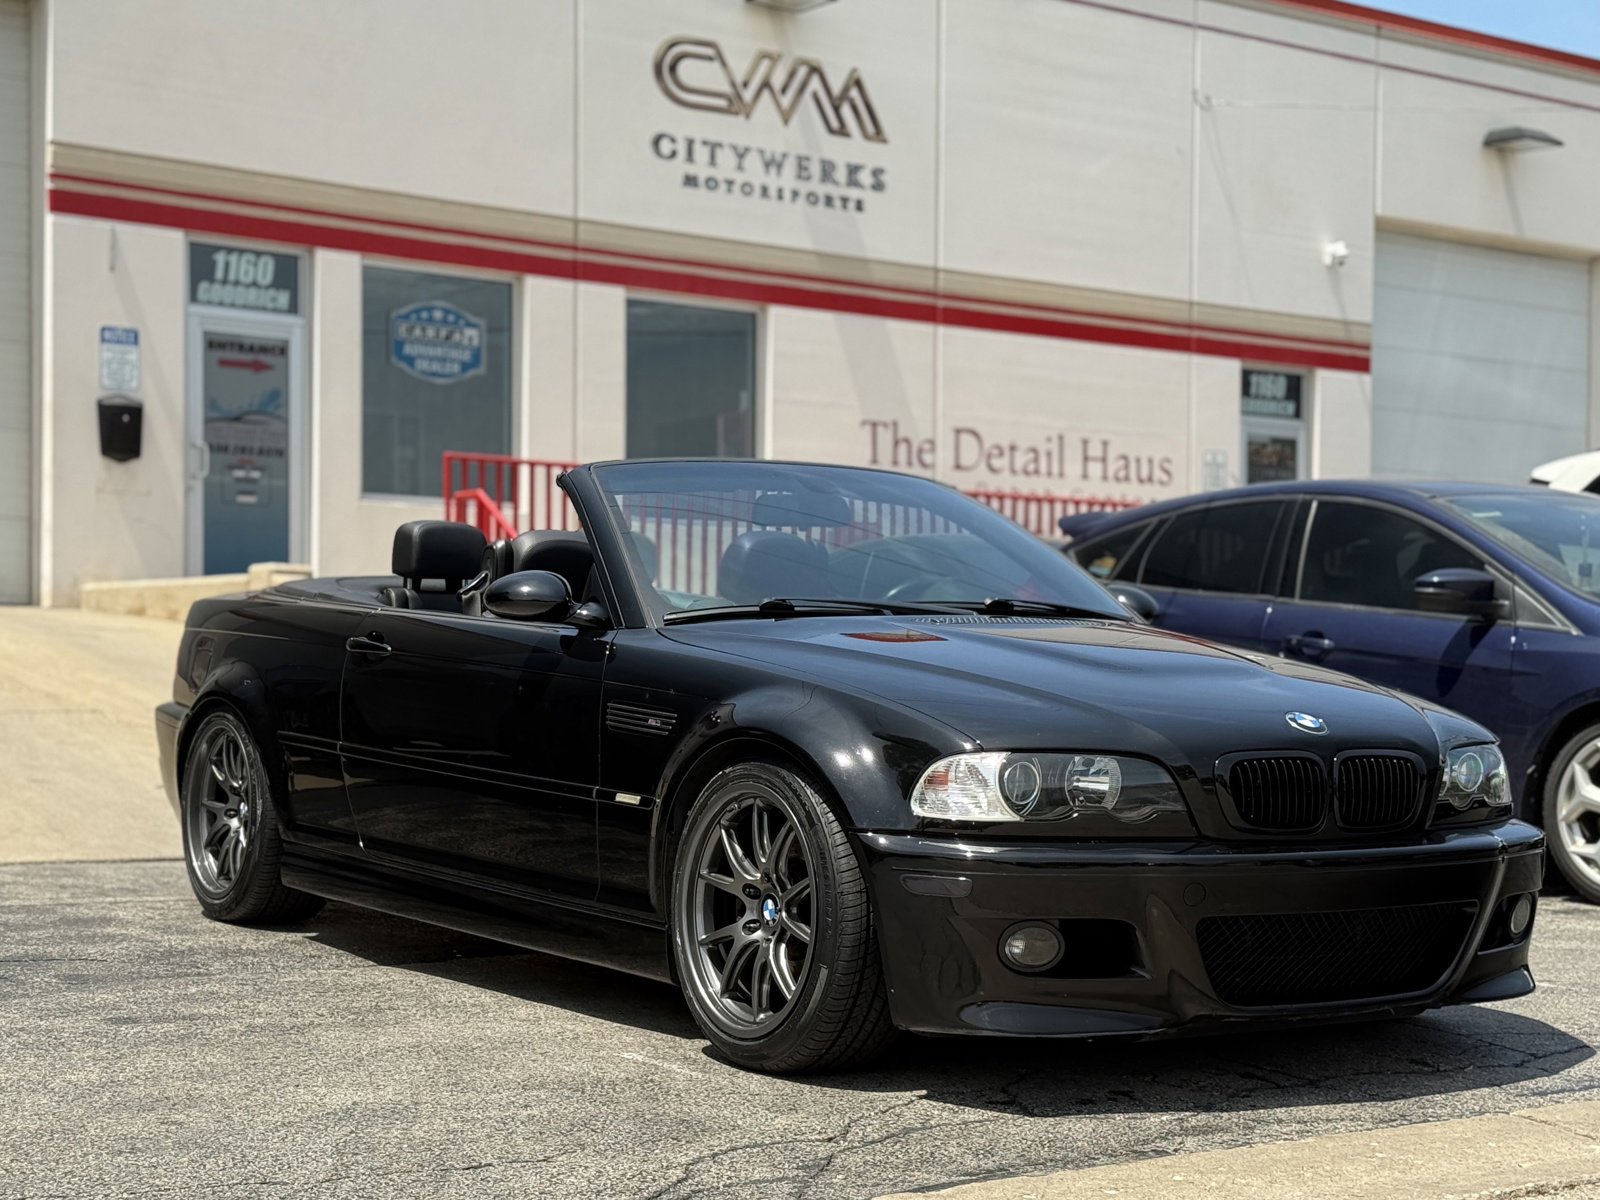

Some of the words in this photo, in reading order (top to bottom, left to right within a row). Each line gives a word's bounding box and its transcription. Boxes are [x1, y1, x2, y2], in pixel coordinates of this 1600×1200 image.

[651, 132, 887, 193] CITYWERKS
[682, 173, 865, 212] MOTORSPORTS
[212, 250, 275, 288] 1160
[196, 280, 291, 311] GOODRICH
[860, 419, 936, 469] The
[953, 427, 1065, 480] Detail
[1080, 437, 1175, 487] Haus
